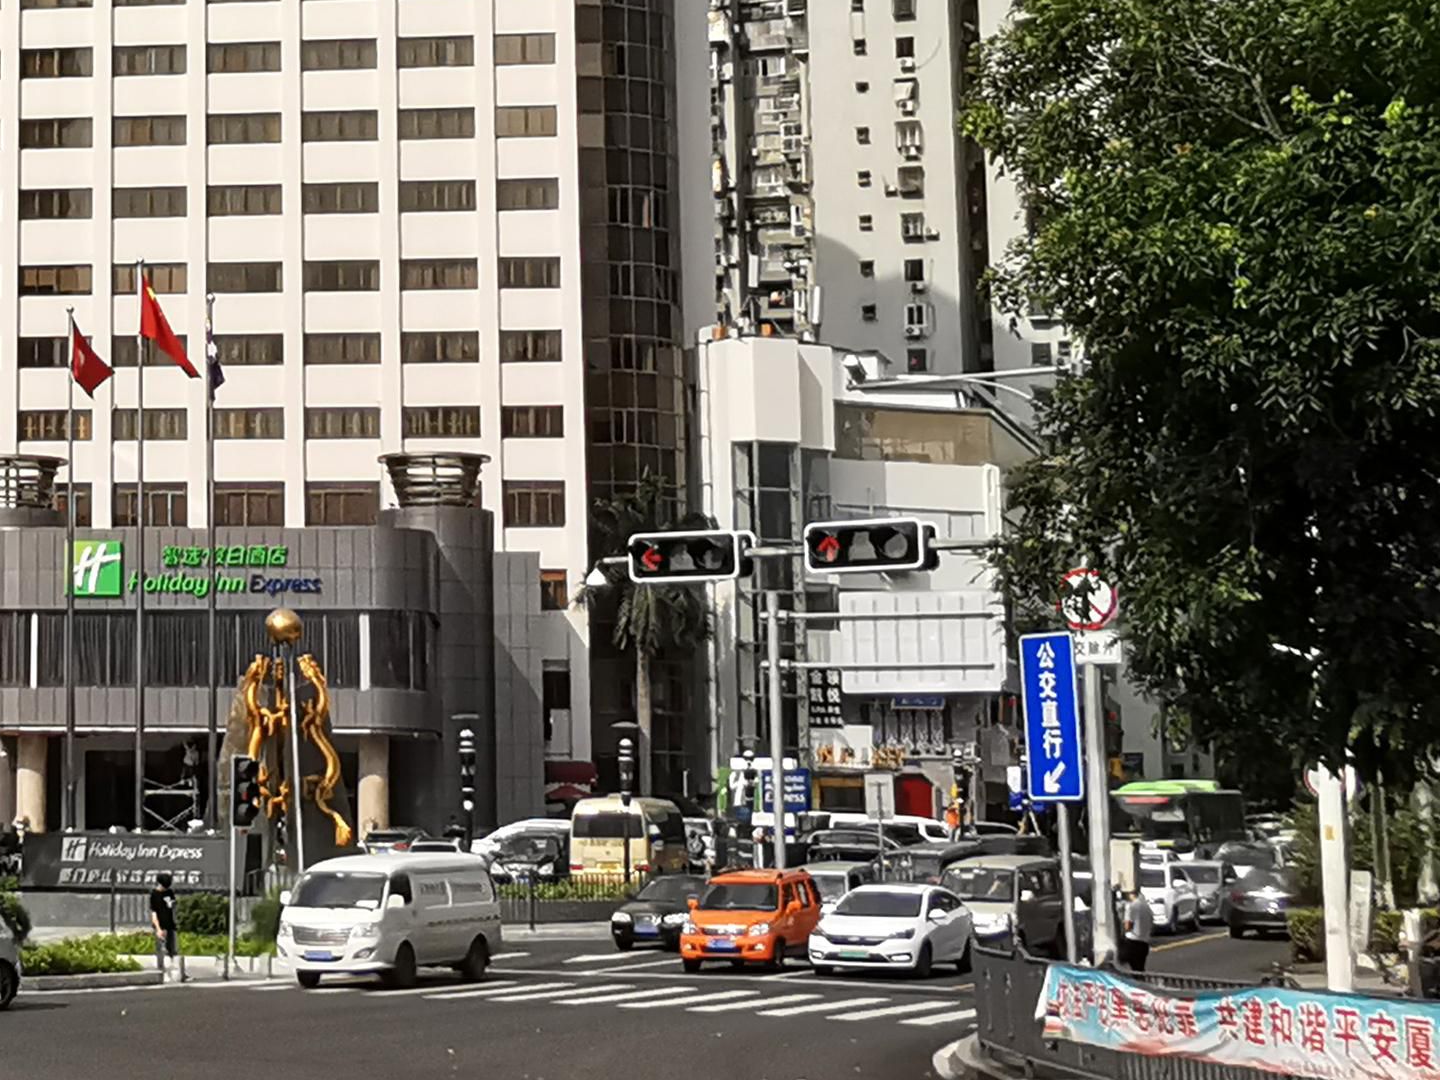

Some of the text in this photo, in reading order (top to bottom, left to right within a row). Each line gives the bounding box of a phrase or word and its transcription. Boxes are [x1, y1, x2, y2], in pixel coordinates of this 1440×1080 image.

[162, 545, 287, 566] 智选假日酒店
[128, 572, 208, 597] Holiday
[249, 575, 323, 597] Express
[1036, 641, 1064, 759] 公交直行
[89, 841, 203, 861] Holiday Inn Express
[1214, 996, 1436, 1071] 共建和谐平安厦
